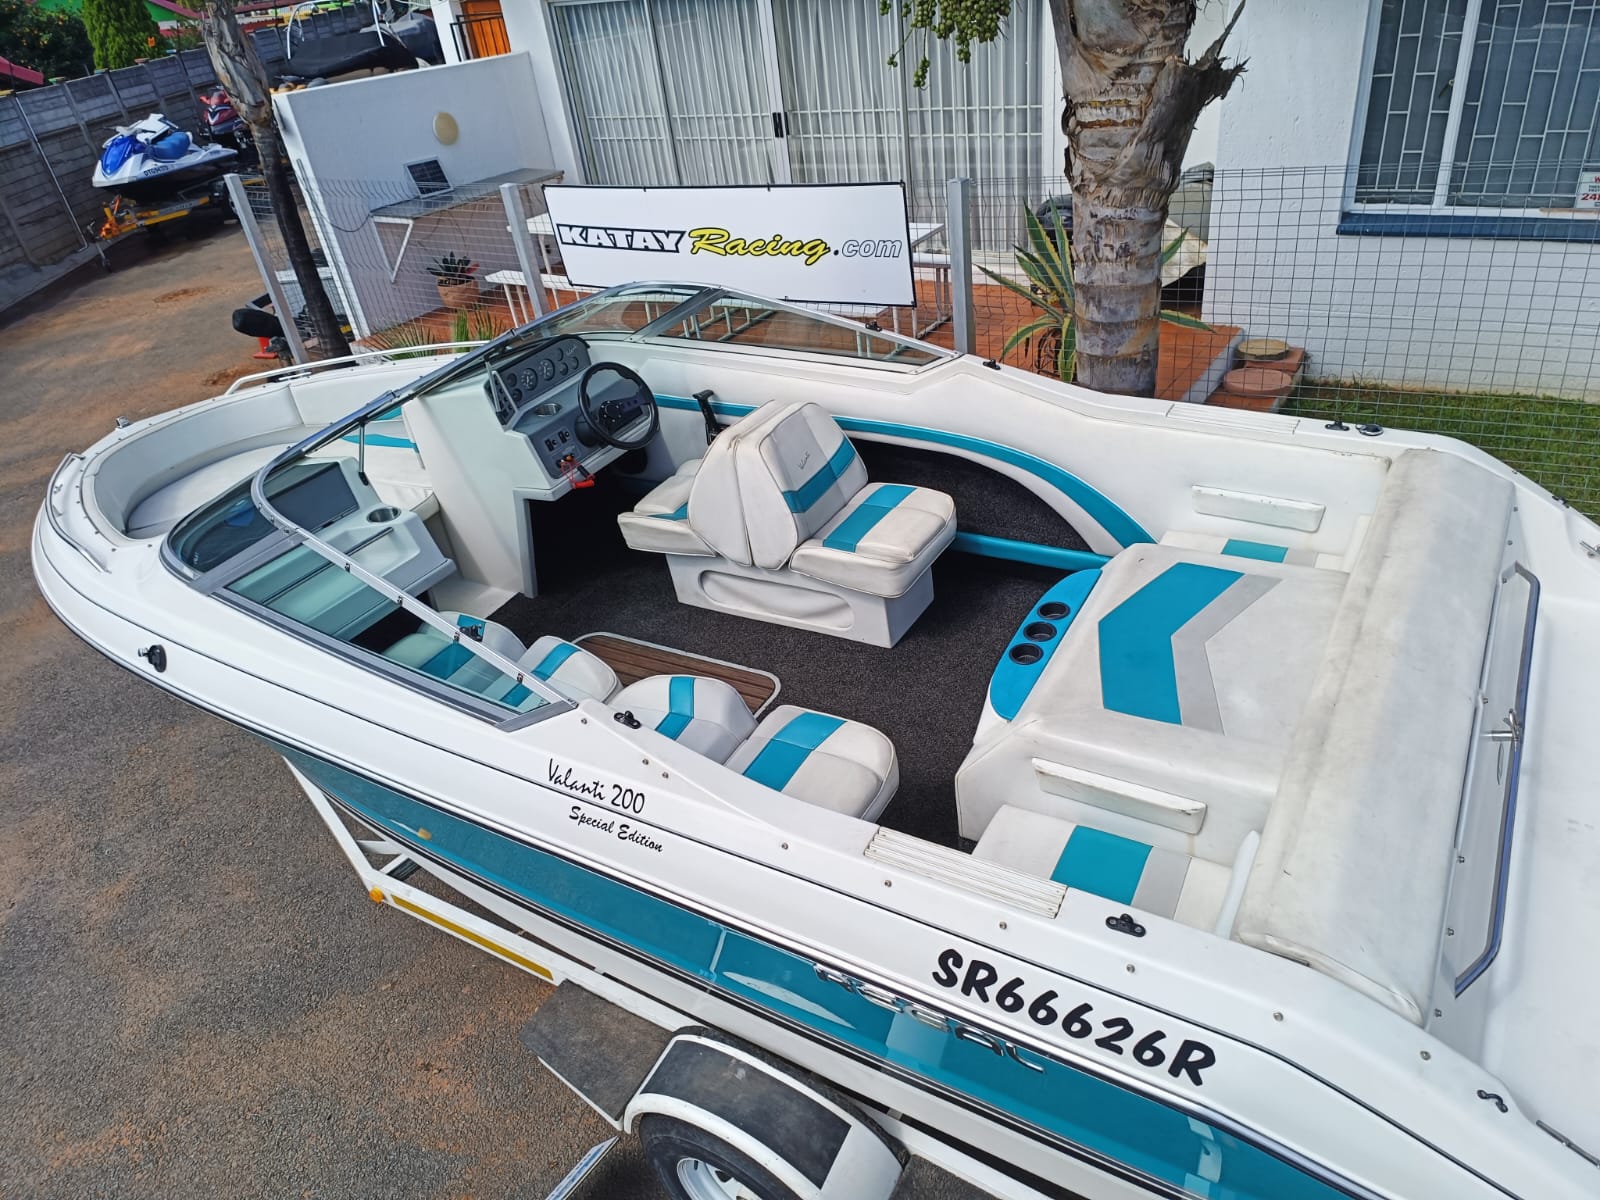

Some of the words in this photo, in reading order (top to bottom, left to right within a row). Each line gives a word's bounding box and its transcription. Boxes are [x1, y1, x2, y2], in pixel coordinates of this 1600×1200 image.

[548, 758, 605, 800] Valanti
[611, 784, 645, 813] 200
[569, 806, 615, 834] Special
[617, 824, 663, 853] Edition
[932, 949, 1216, 1087] SR66626R
